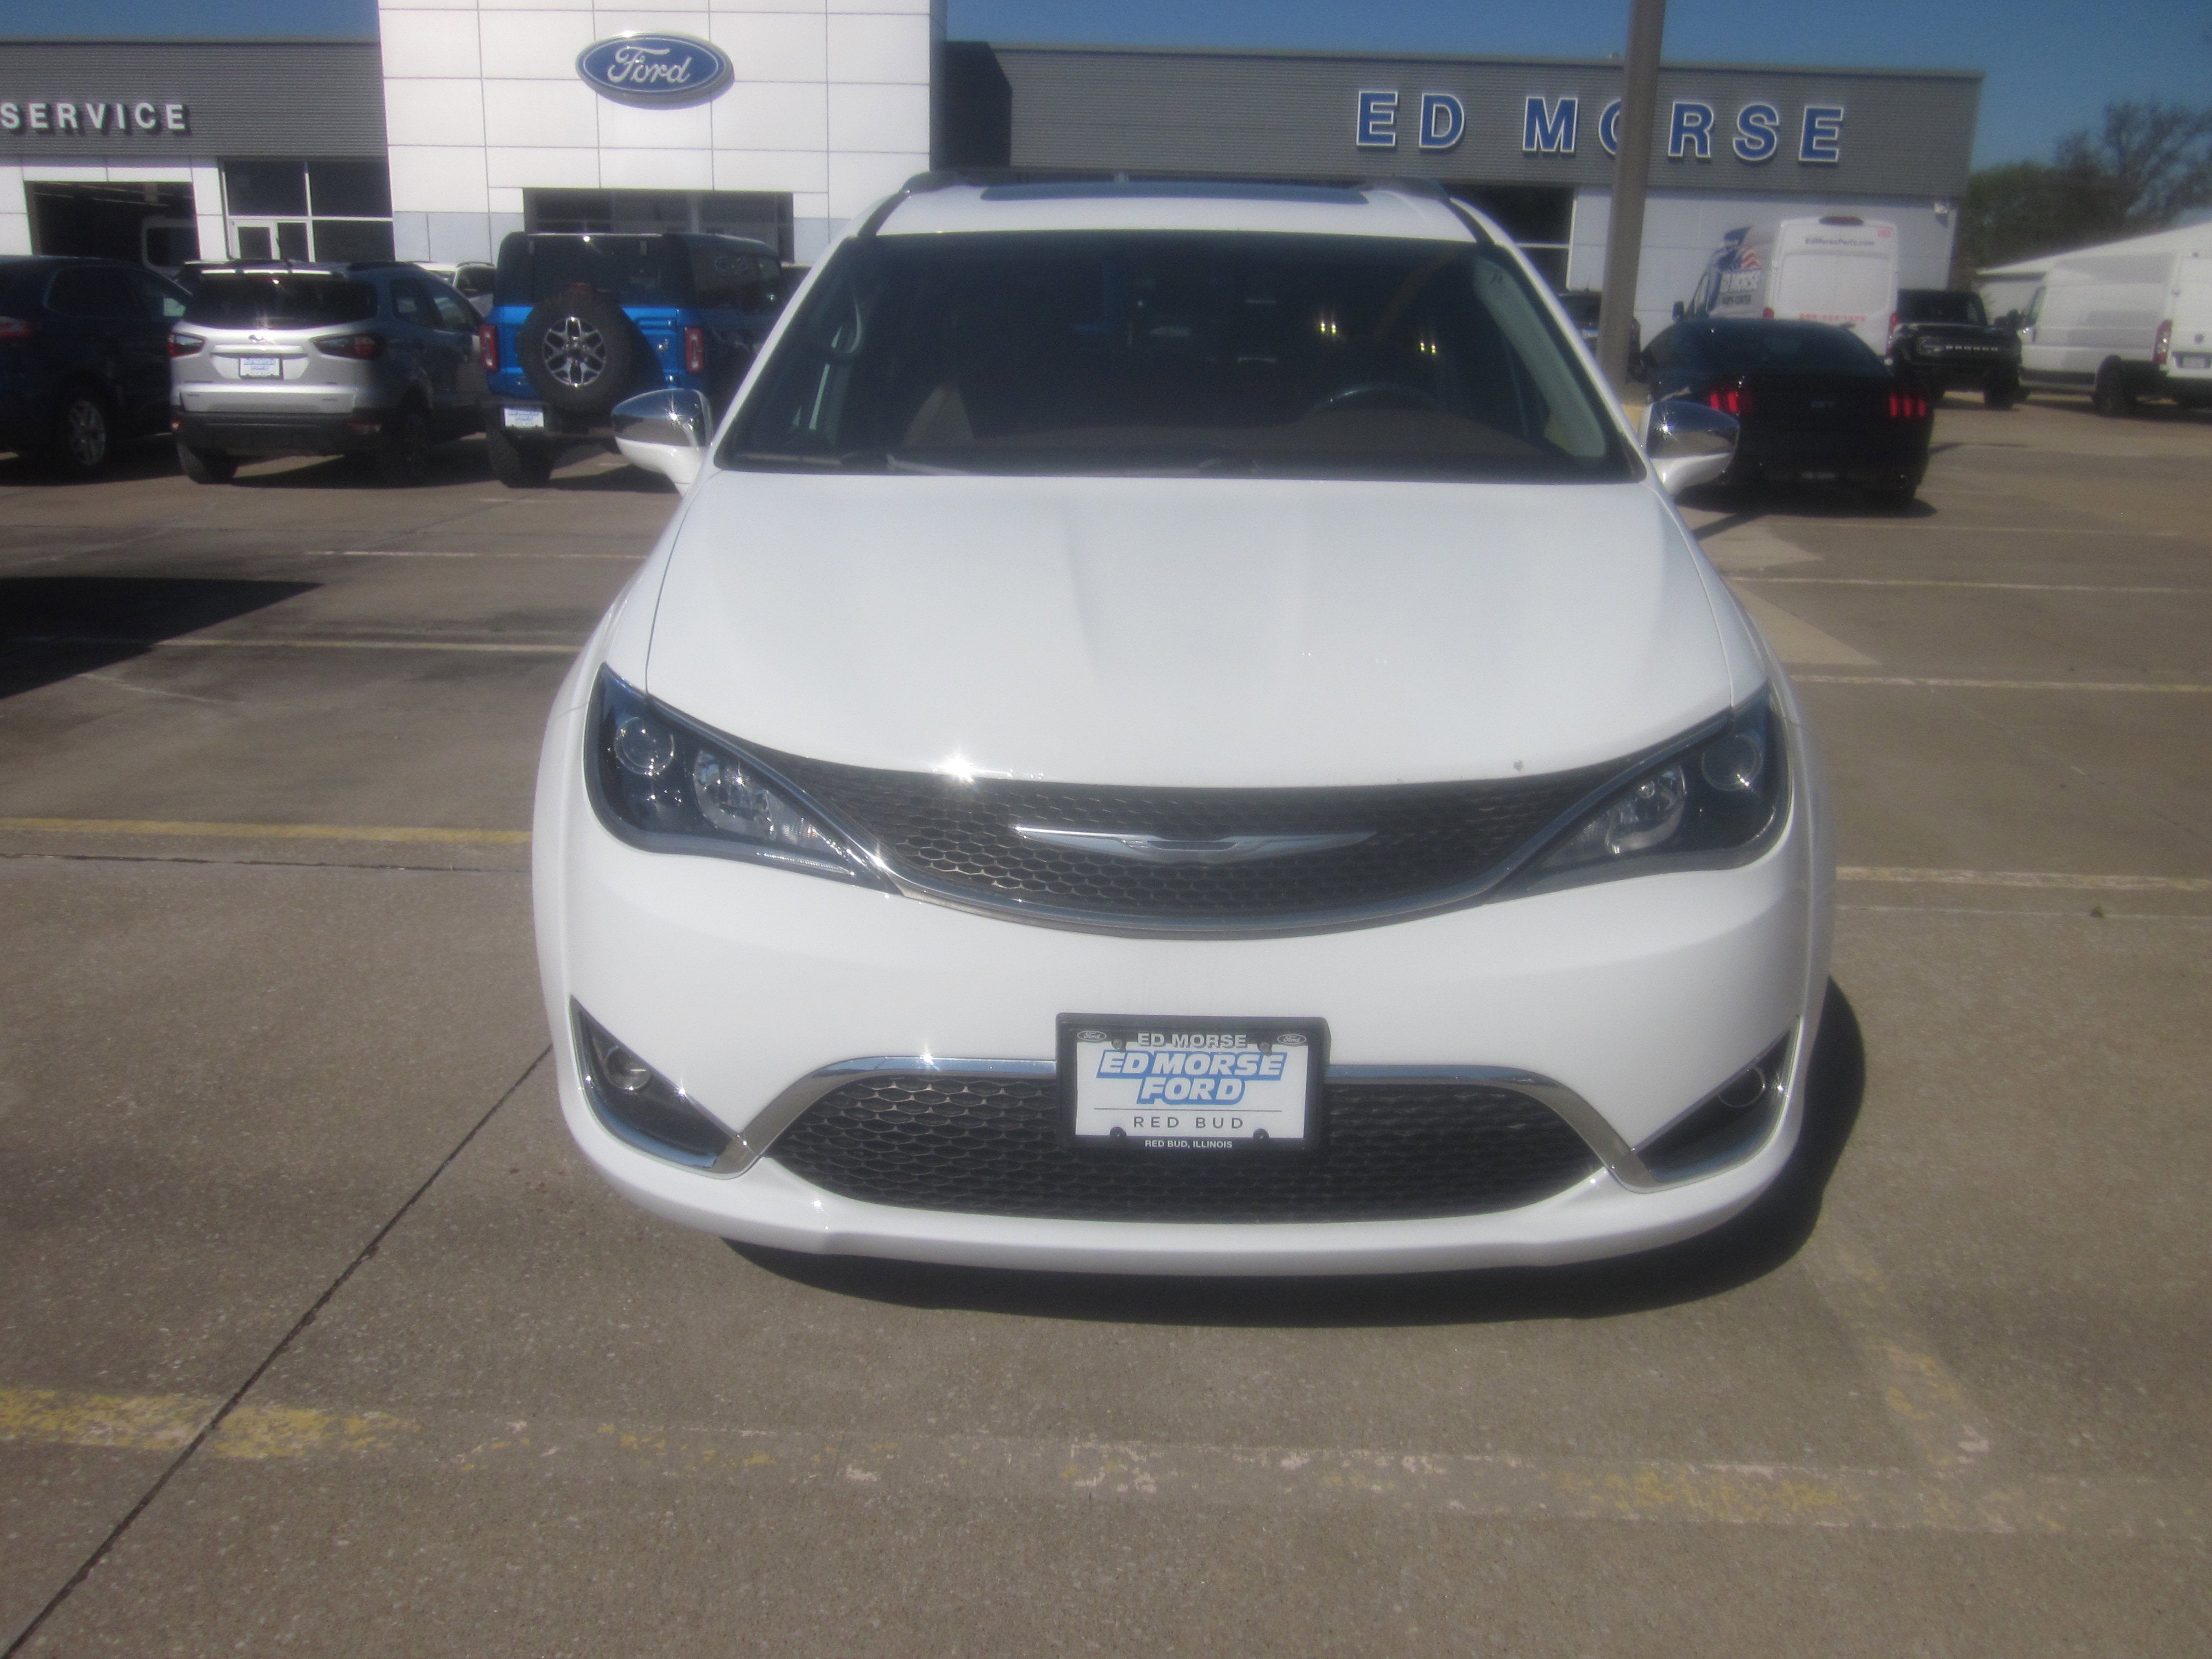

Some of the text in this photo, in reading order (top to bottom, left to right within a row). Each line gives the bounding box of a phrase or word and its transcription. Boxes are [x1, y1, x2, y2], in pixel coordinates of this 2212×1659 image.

[607, 46, 692, 83] Ford
[0, 102, 186, 129] SERVICE
[1356, 90, 1465, 148] ED
[1083, 1031, 1101, 1040] Ford
[1138, 1033, 1246, 1048] ED MORSE
[1284, 1035, 1301, 1043] Ford
[1100, 1051, 1284, 1076] ED MORSE
[1140, 1076, 1243, 1100] FORD
[1134, 1116, 1243, 1129] RED BUD
[1167, 1140, 1190, 1149] BUD,
